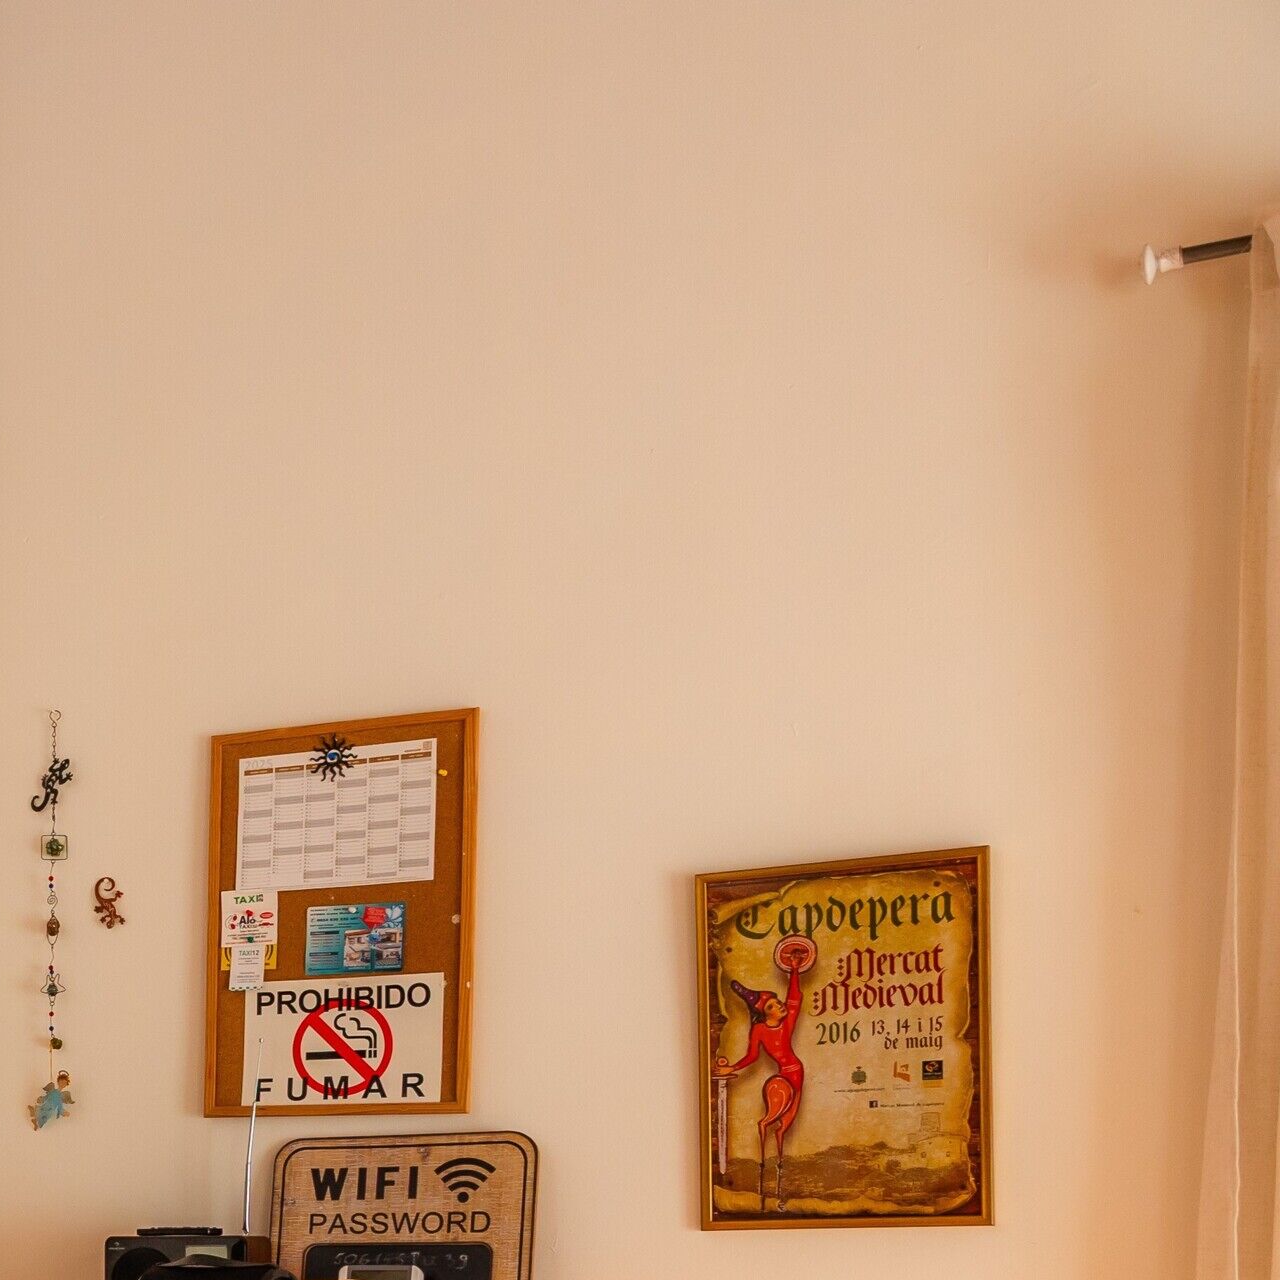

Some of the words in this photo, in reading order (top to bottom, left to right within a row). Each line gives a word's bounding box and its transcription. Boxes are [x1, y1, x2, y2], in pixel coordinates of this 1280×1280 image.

[736, 891, 955, 941] Capdepera
[835, 943, 944, 982] Mercat
[256, 983, 431, 1015] PROHIBIDO
[809, 970, 946, 1016] Medieval
[816, 1021, 860, 1045] 2016
[897, 1018, 910, 1034] 14
[930, 1016, 943, 1032] 15
[884, 1035, 898, 1049] de
[906, 1033, 943, 1050] maig
[311, 1166, 418, 1200] WIFI
[309, 1211, 491, 1234] PASSWORD
